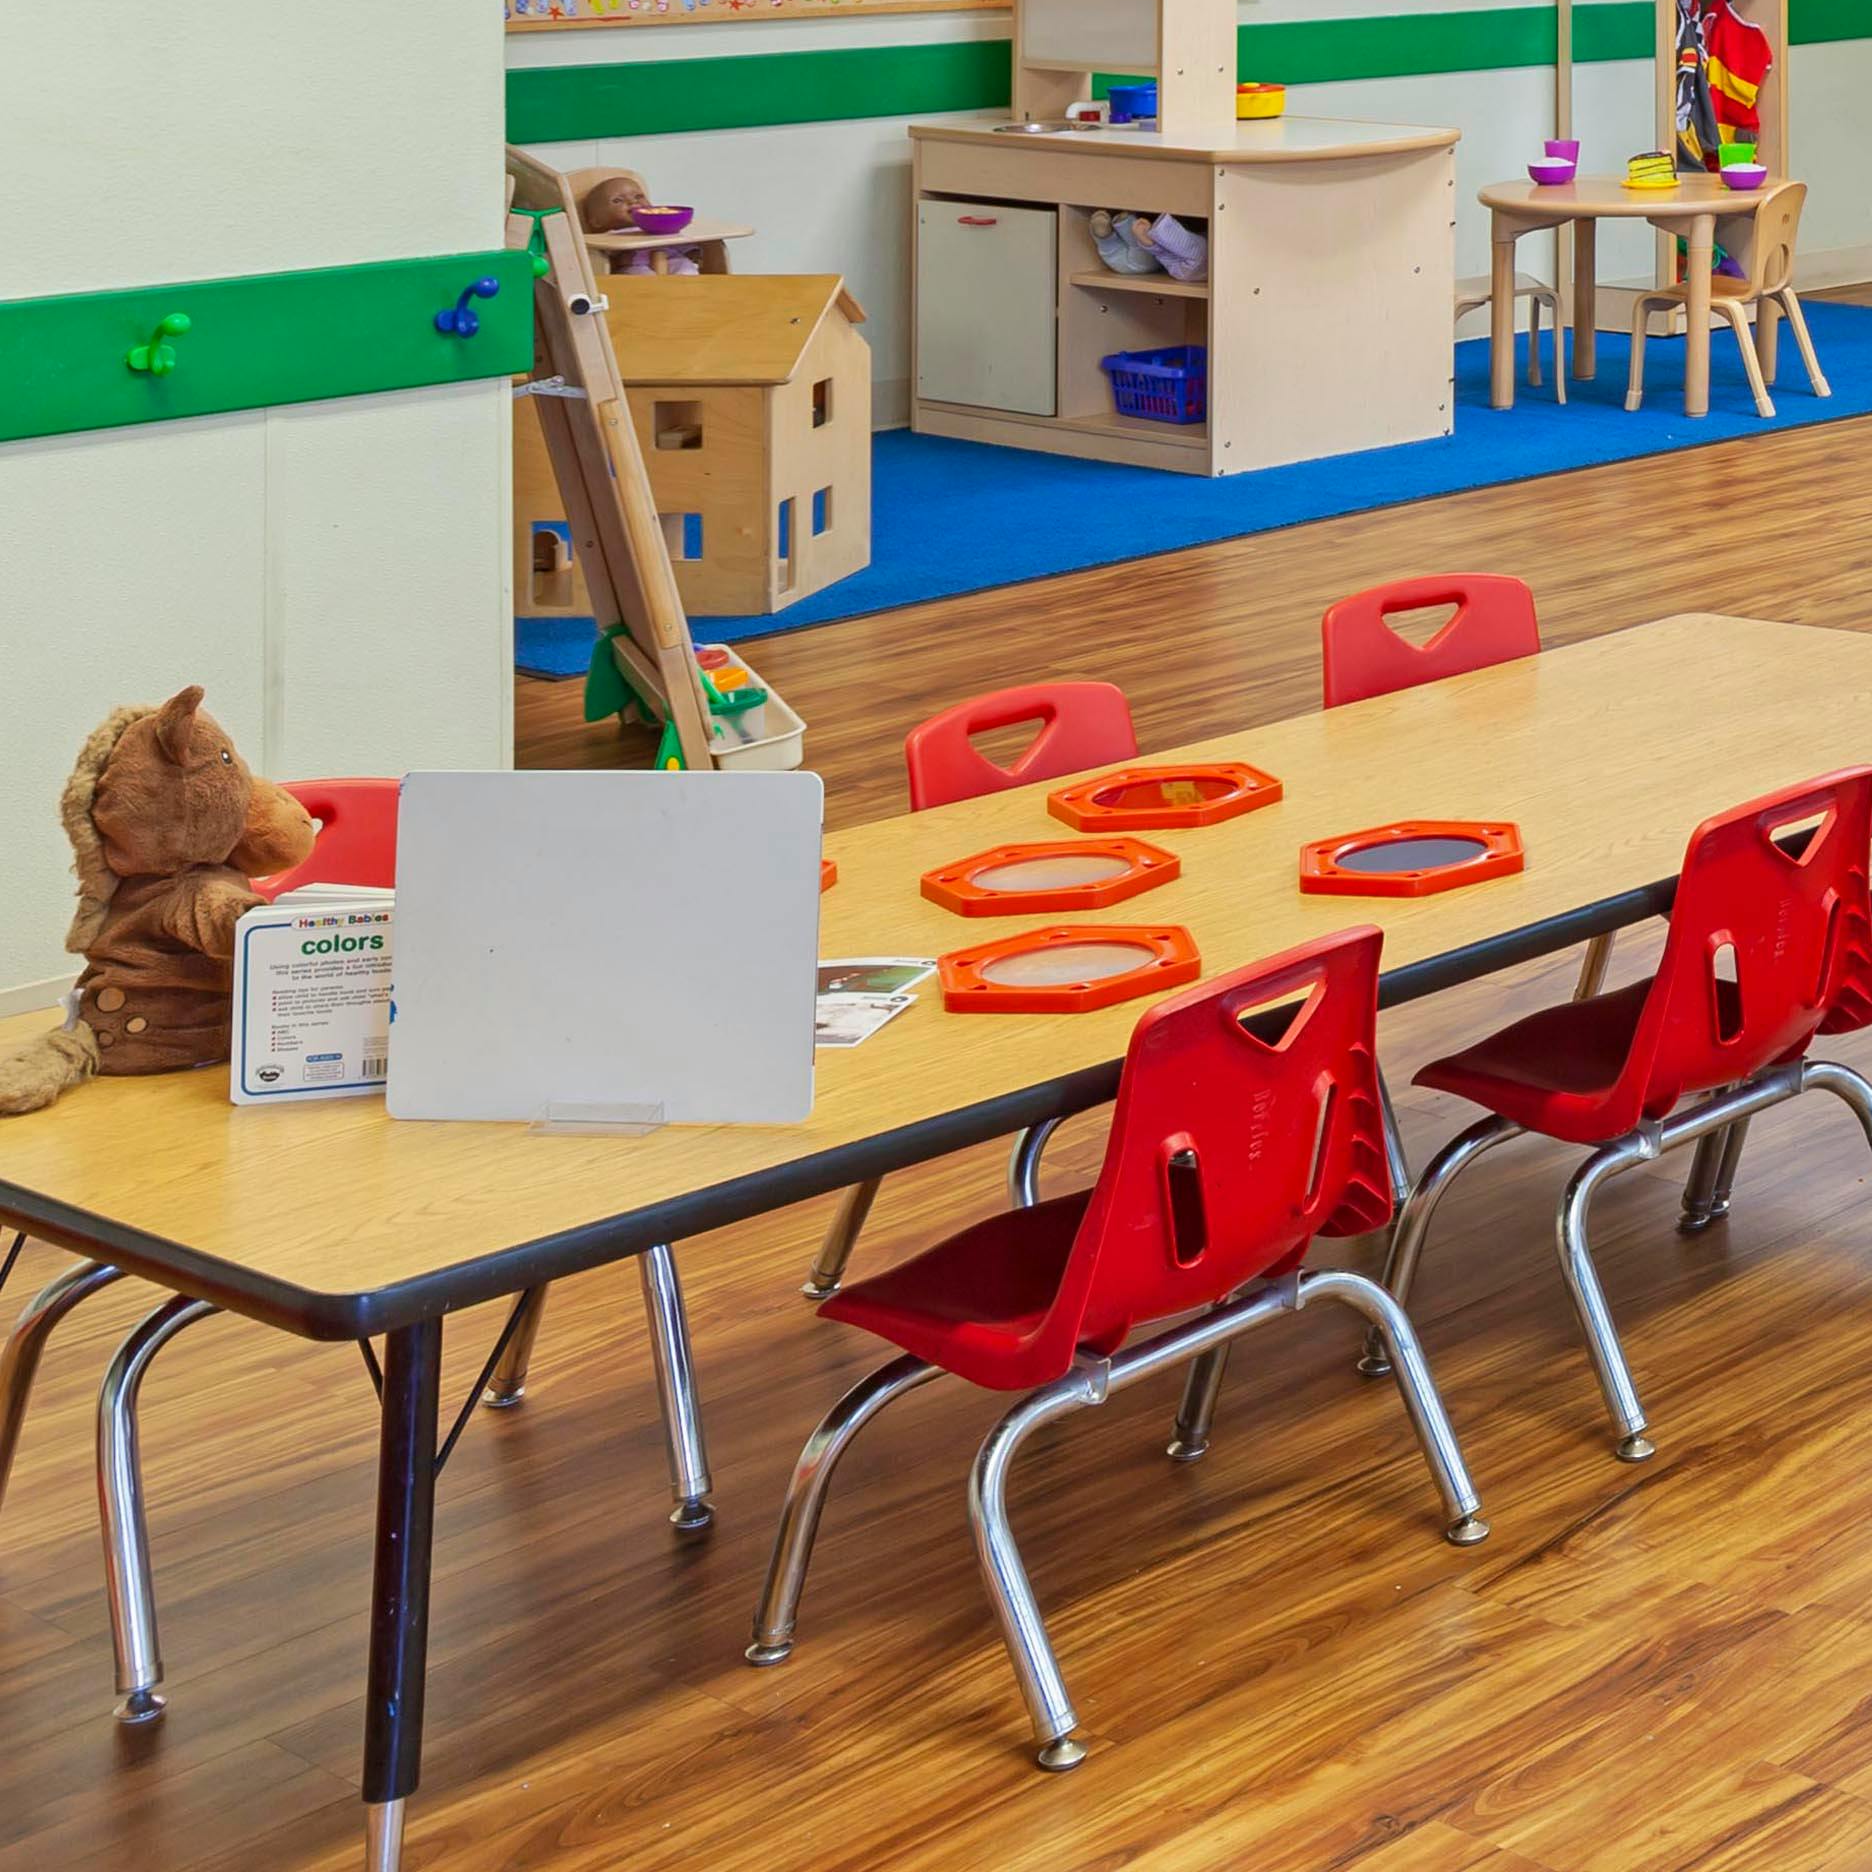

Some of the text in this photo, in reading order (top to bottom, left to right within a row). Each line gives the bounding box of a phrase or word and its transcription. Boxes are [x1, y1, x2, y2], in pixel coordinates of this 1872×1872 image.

[299, 911, 390, 929] Healthy Babies
[301, 934, 385, 956] colors
